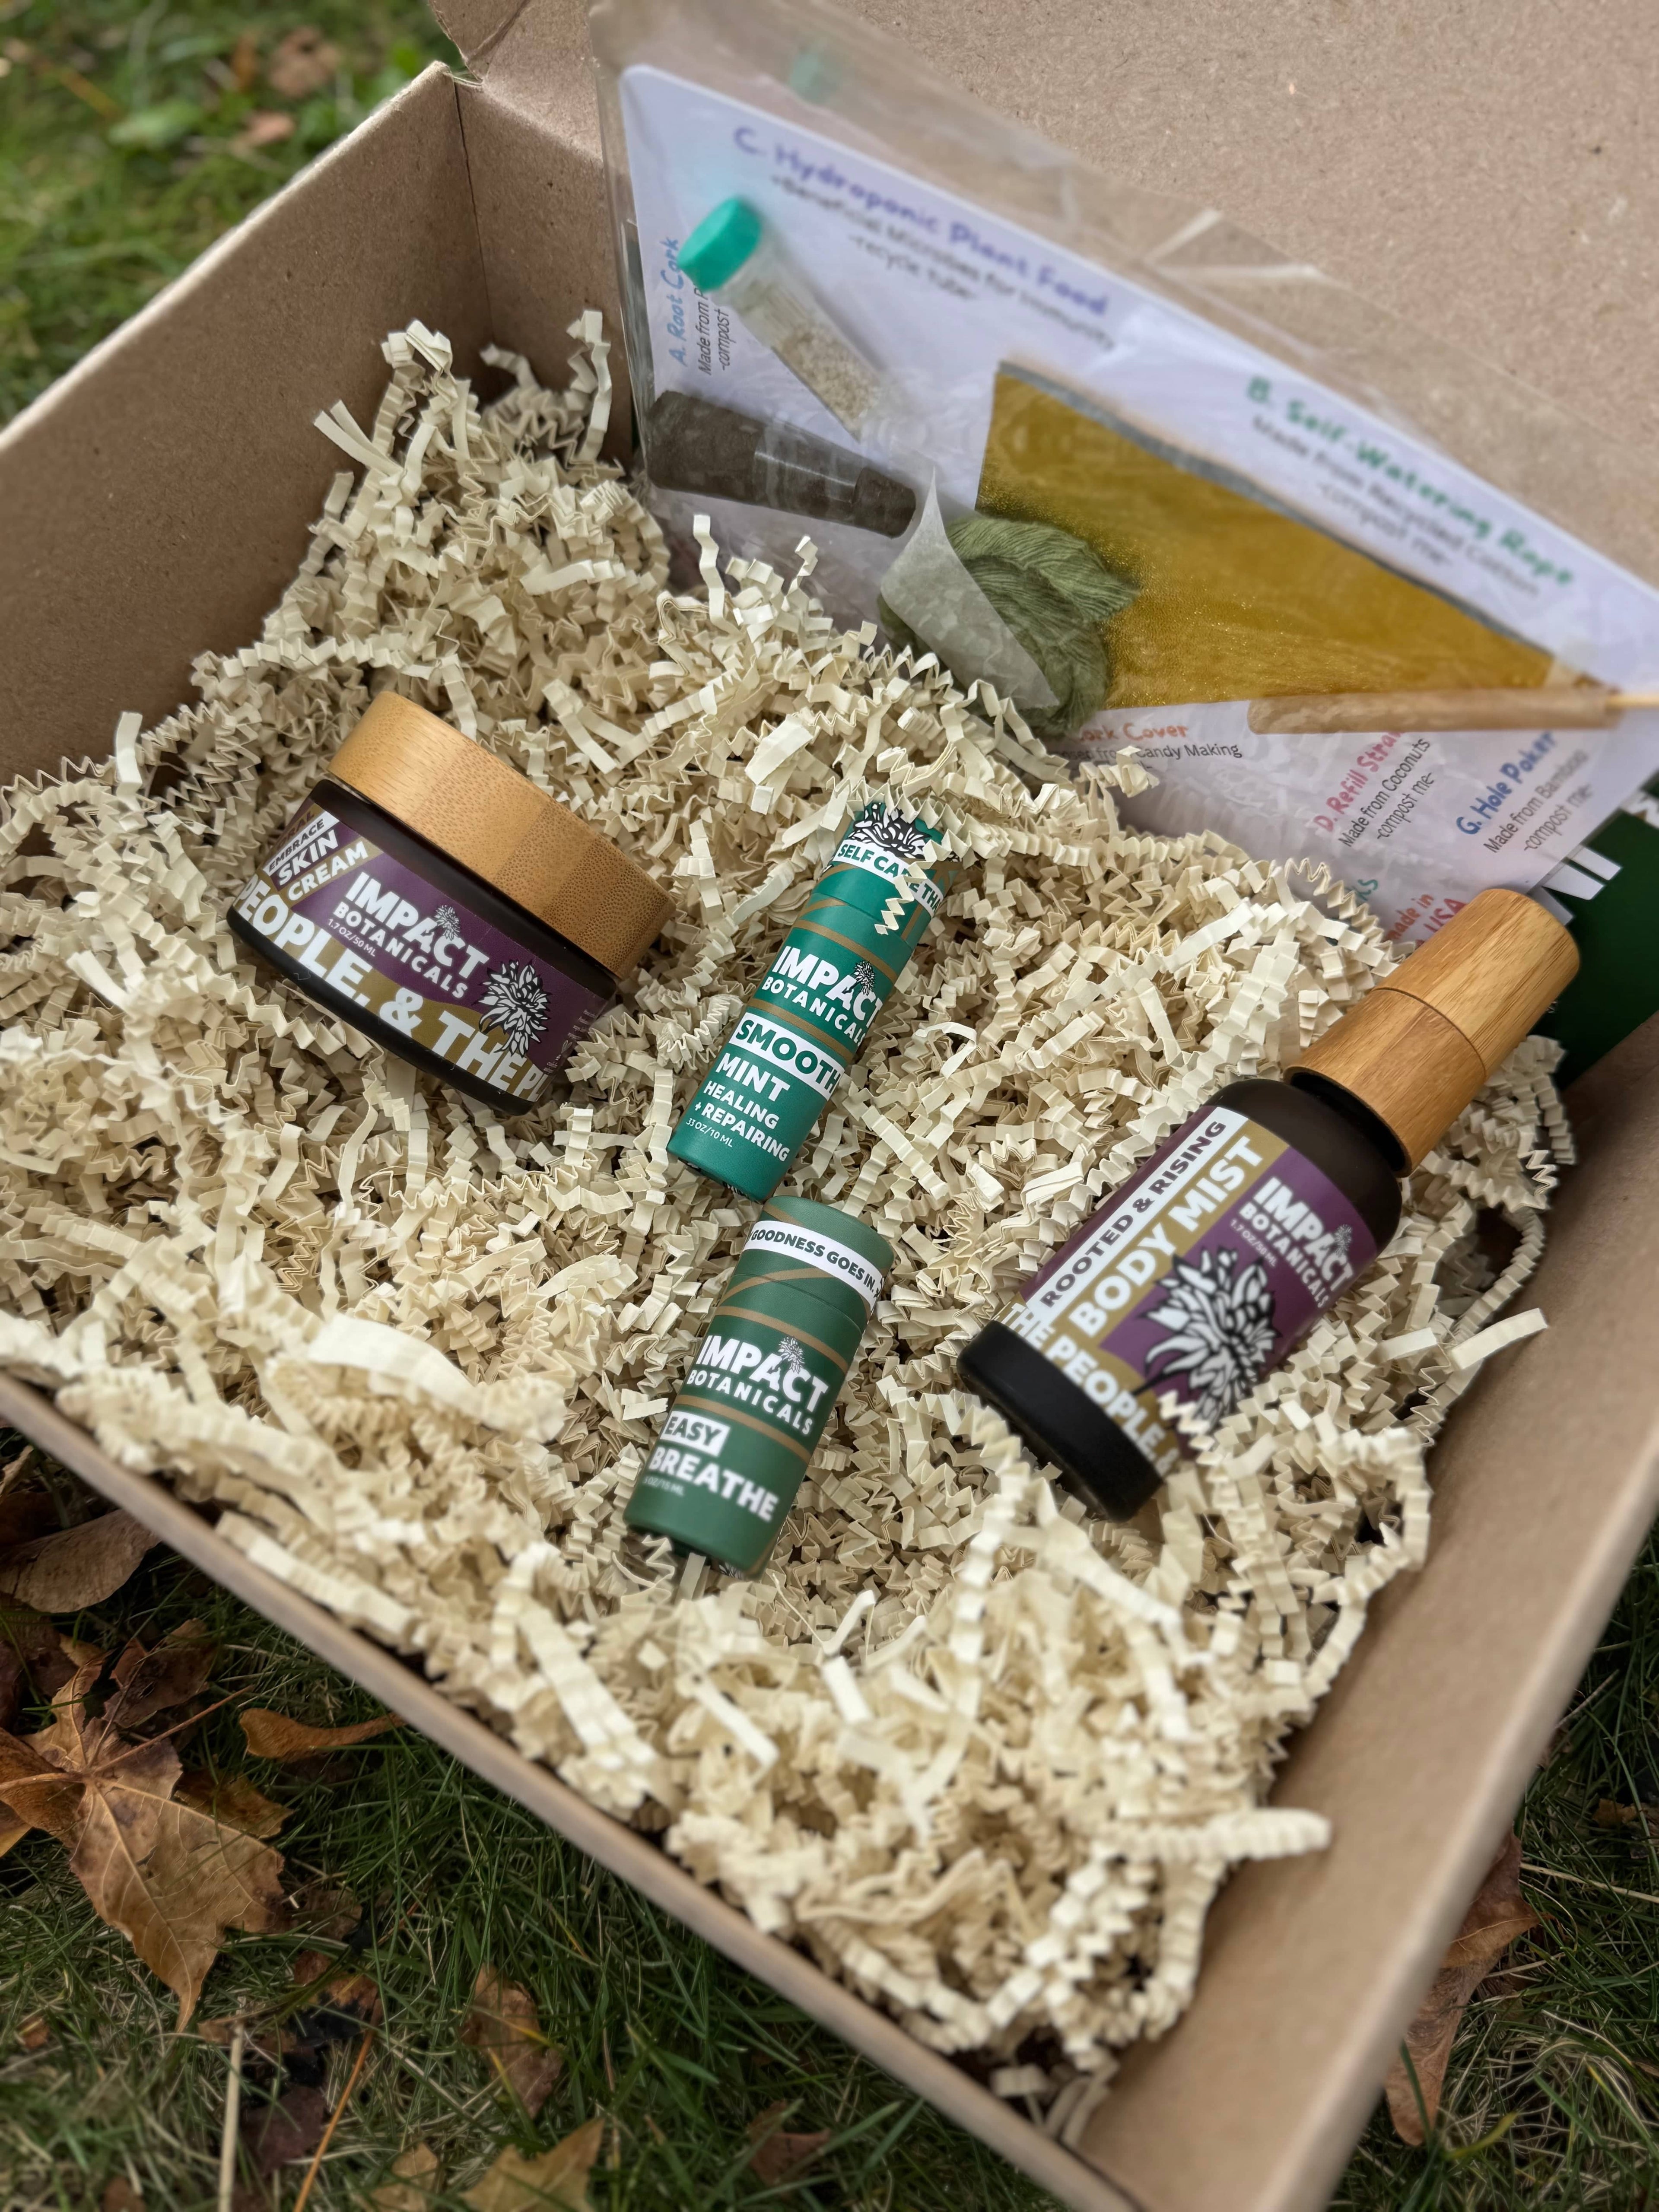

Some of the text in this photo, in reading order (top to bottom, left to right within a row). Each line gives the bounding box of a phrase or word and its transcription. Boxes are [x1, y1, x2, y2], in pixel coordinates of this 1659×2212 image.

[775, 143, 939, 234] Hydroponic
[950, 221, 1027, 277] Plant
[1038, 264, 1109, 316] Food
[660, 237, 684, 289] Cork
[667, 294, 686, 341] Root
[695, 302, 711, 337] from
[697, 337, 711, 375] Made
[1123, 722, 1189, 741] Cover
[1135, 746, 1181, 760] Candy
[1185, 743, 1243, 758] Making
[1326, 769, 1369, 814] Refill
[1338, 738, 1430, 847] Made from Coconuts
[1470, 782, 1512, 819] Hole
[269, 818, 324, 873] EMBRACE
[1483, 823, 1519, 853] Made
[1510, 797, 1544, 825] from
[279, 829, 338, 886] SKIN
[288, 841, 369, 901] CREAM
[838, 844, 874, 863] SELF
[328, 918, 376, 957] 1.7 OZ/50 ML
[333, 901, 468, 998] BOTANICALS
[346, 872, 489, 979] IMPACT
[762, 946, 883, 1046] IMPACT BOTANICALS
[379, 988, 423, 1037] &
[432, 1010, 528, 1091] THE
[735, 1020, 841, 1094] SMOOTH
[703, 1081, 779, 1129] HEALING
[716, 1053, 791, 1102] MINT
[695, 1122, 721, 1139] OZ/10
[720, 1135, 733, 1147] ML
[701, 1103, 790, 1162] REPAIRING
[1040, 1120, 1227, 1308] ROOTED & RISING
[1068, 1135, 1263, 1338] BODY MIST
[1253, 1176, 1354, 1292] IMPACT
[751, 1229, 826, 1257] GOODNESS
[827, 1251, 864, 1281] GOES
[1239, 1201, 1329, 1308] BOTANICALS
[1264, 1252, 1278, 1267] ML
[999, 1302, 1055, 1349] THE
[695, 1335, 829, 1414] IMPACT
[686, 1370, 813, 1437] BOTANICALS
[664, 1416, 724, 1447] EASY
[648, 1446, 779, 1523] BREATHE
